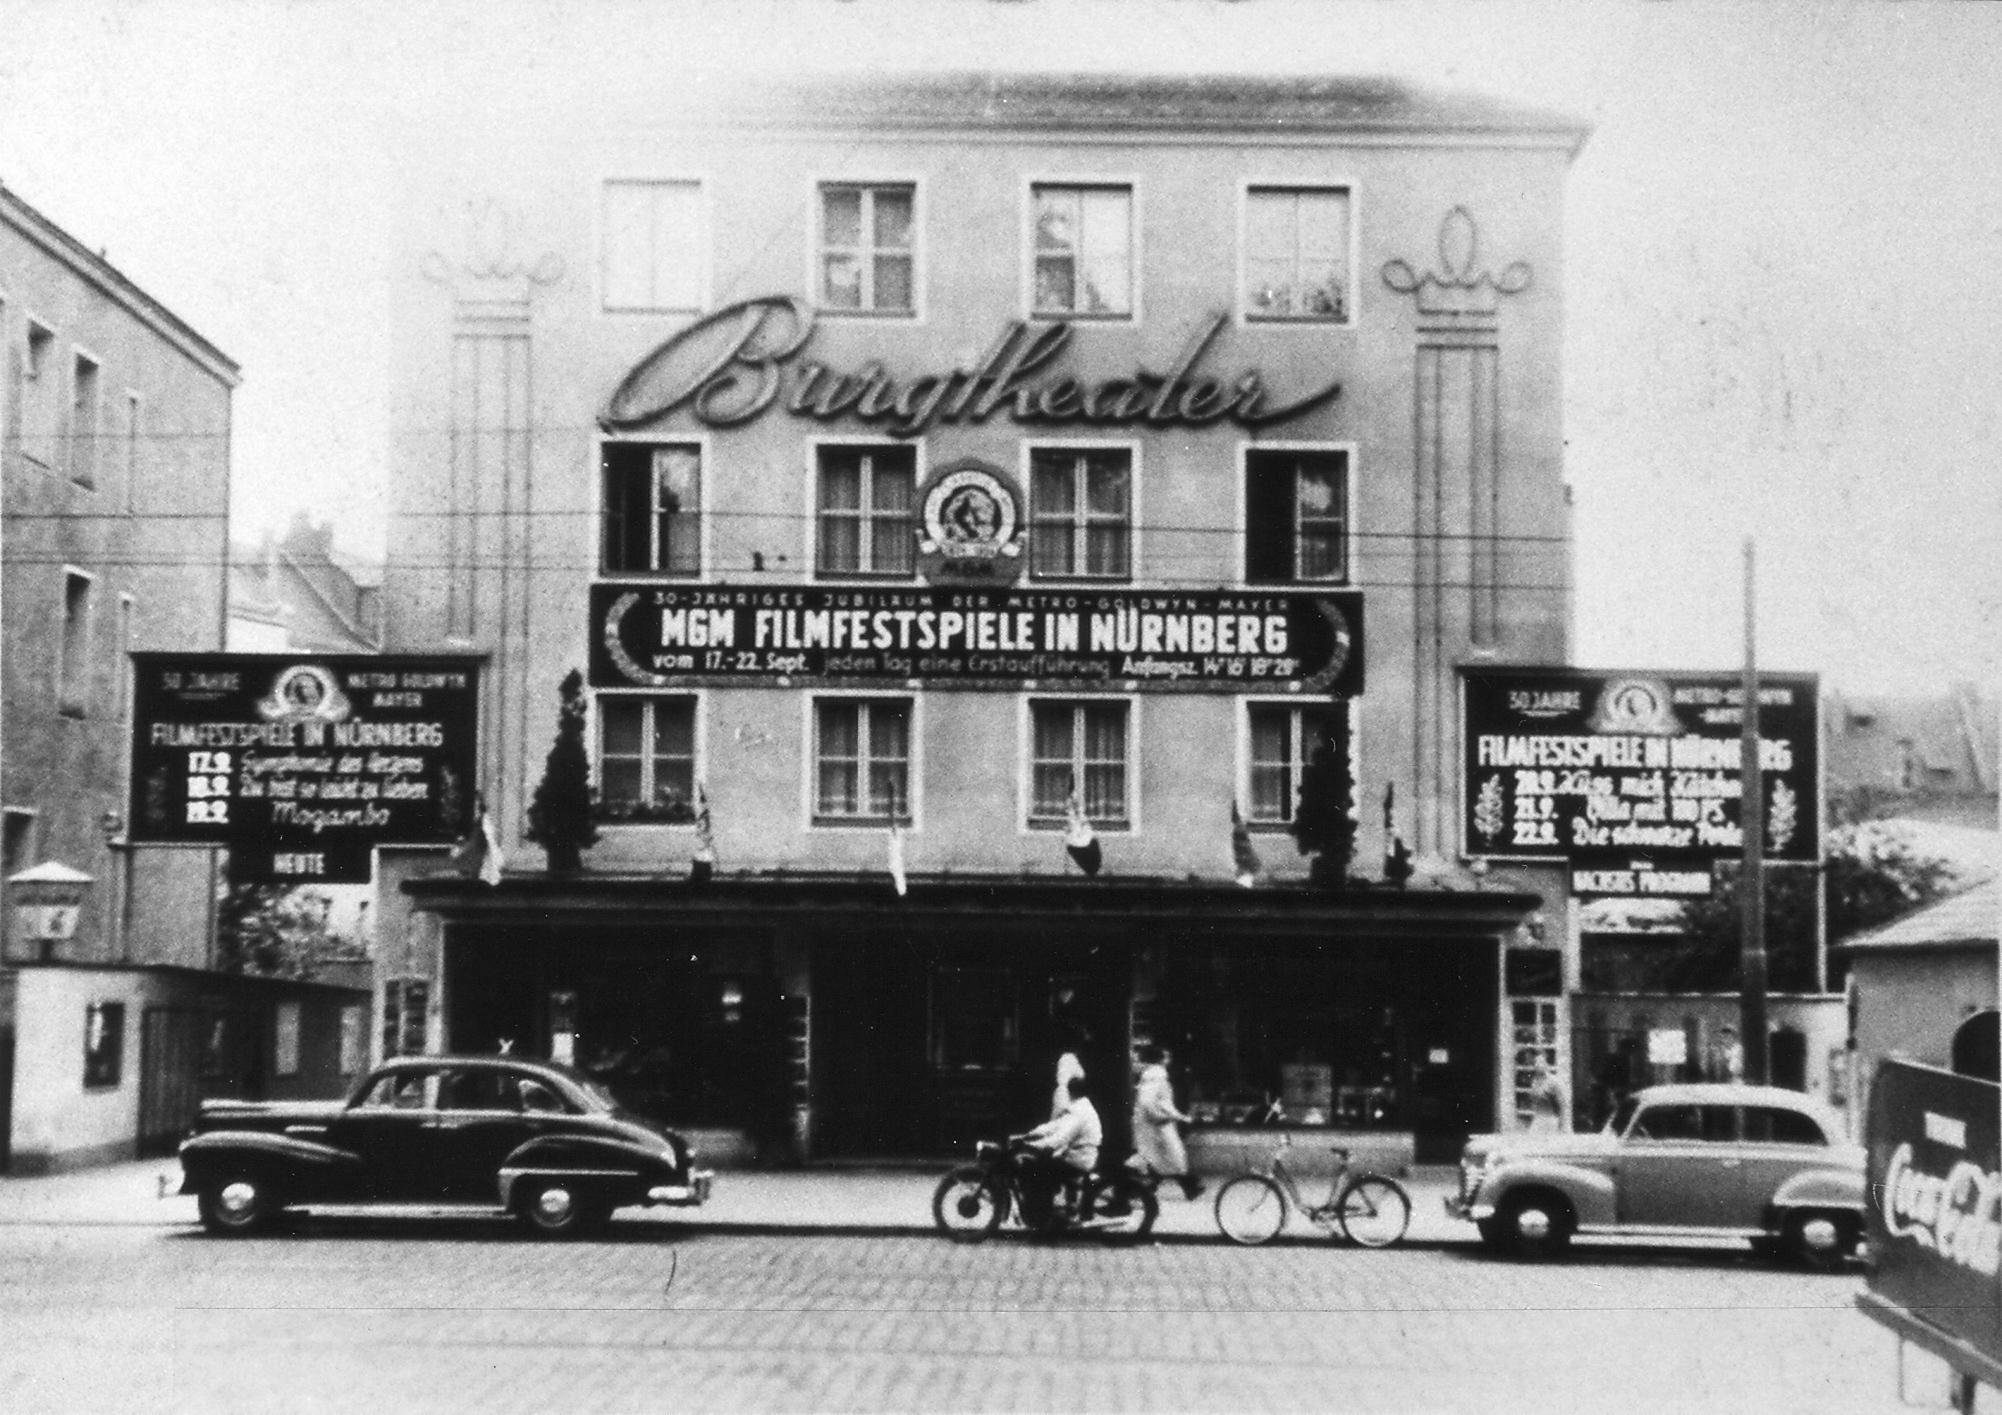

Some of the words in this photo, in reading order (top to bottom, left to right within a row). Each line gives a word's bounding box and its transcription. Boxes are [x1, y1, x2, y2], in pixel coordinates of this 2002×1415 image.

[597, 298, 1345, 438] Burgtheater
[953, 595, 988, 608] DER
[662, 609, 734, 647] MGM
[755, 610, 1034, 650] FILMFESTSPIELE
[1045, 613, 1078, 651] IN
[1091, 606, 1287, 654] NÜRNBERG
[654, 655, 693, 668] vom
[767, 652, 808, 674] Sept.
[919, 658, 961, 671] eine
[152, 721, 296, 747] FILMFESTSPIELE
[302, 721, 326, 746] IN
[332, 716, 443, 747] NÜRNBERG
[1479, 735, 1644, 767] FILMFESTSPIELE
[273, 801, 390, 833] Mogambo
[274, 853, 324, 874] HEUTE
